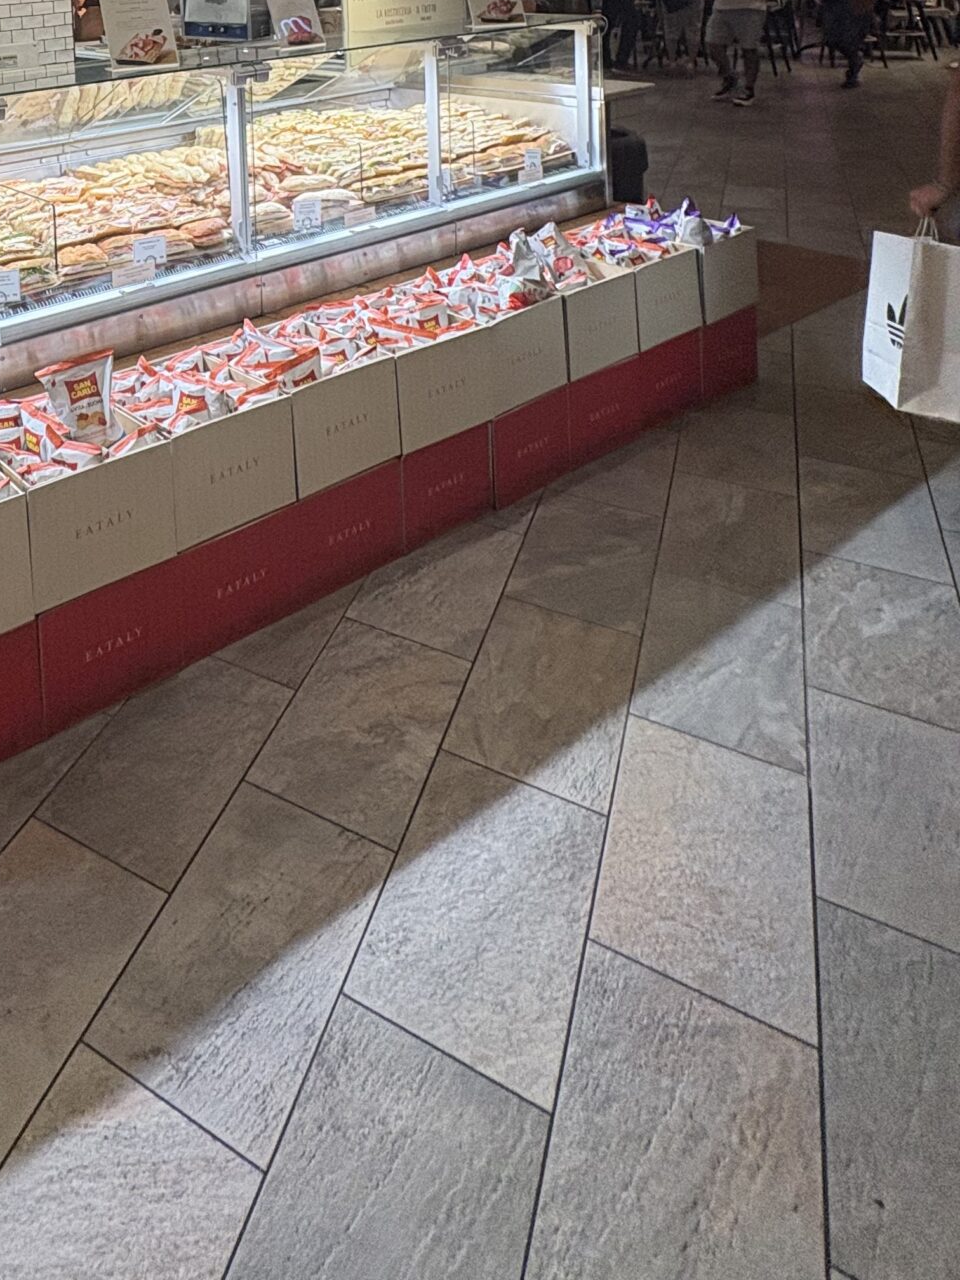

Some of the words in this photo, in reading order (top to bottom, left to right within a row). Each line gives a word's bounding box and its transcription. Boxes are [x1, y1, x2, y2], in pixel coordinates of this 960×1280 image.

[71, 384, 98, 399] CARLO
[73, 379, 91, 391] SAN
[209, 455, 260, 486] EATALY
[74, 508, 136, 541] EATALY
[217, 566, 269, 600] EATALY
[85, 626, 142, 663] EATALY
